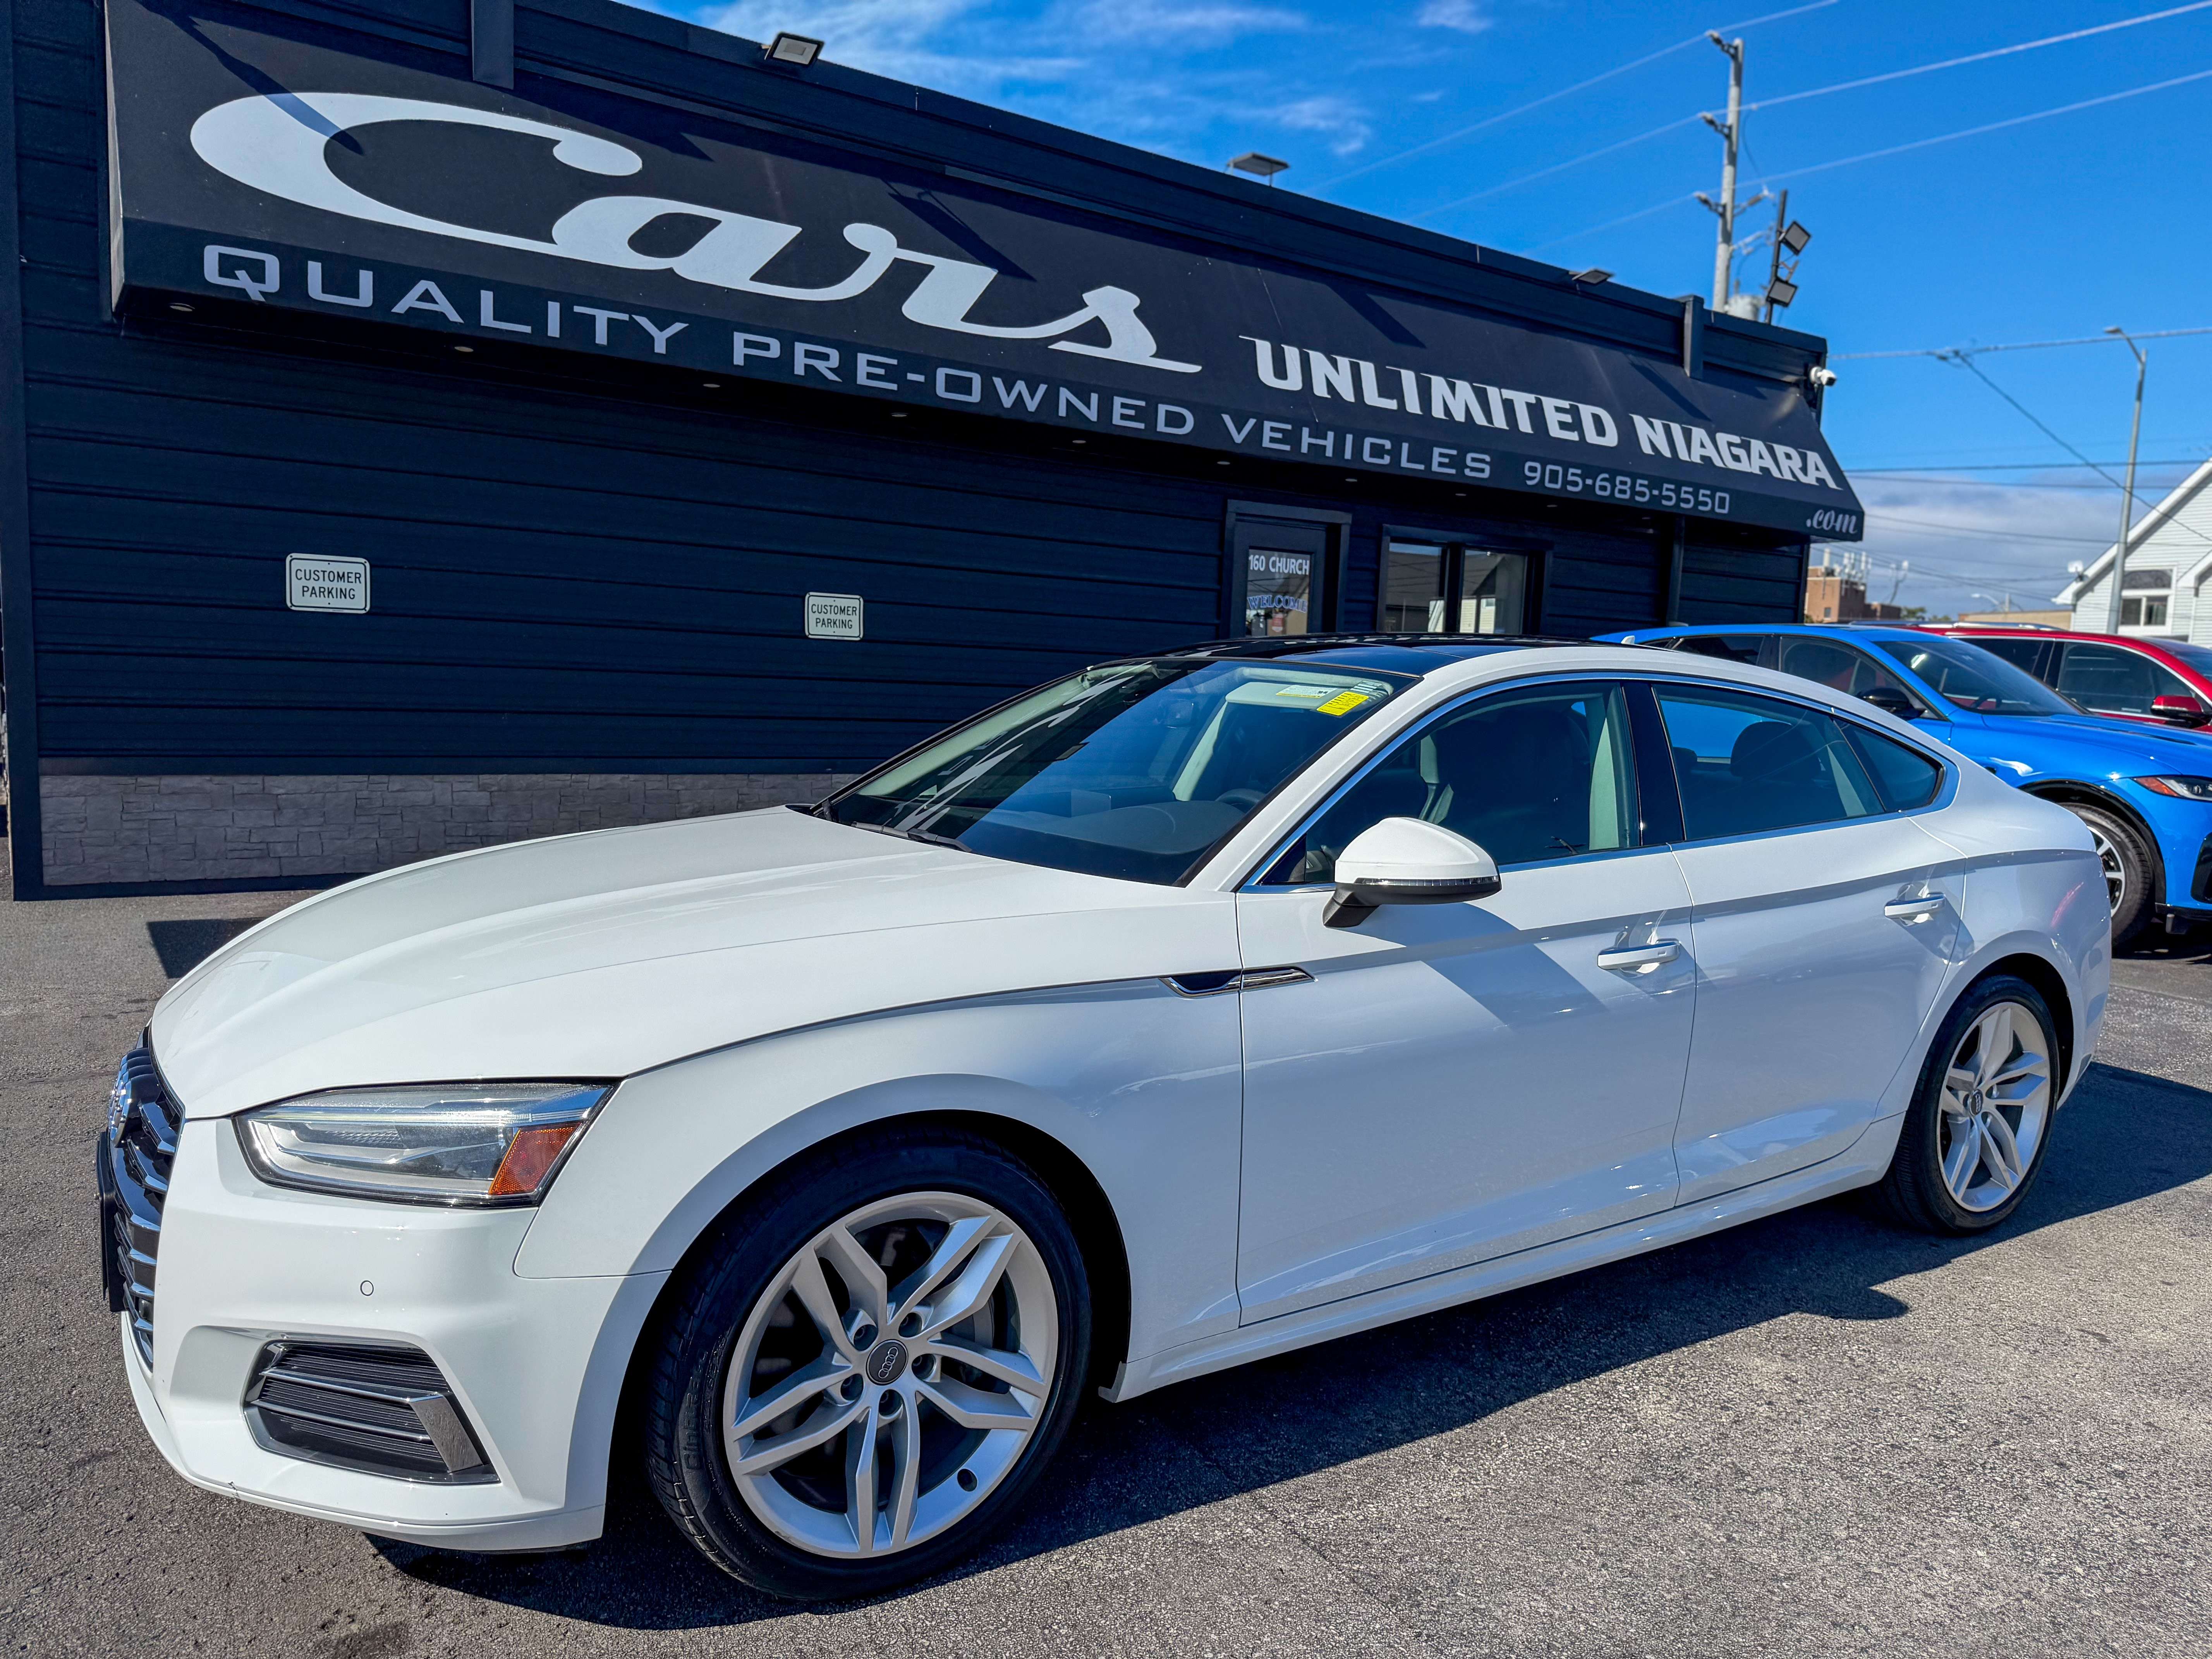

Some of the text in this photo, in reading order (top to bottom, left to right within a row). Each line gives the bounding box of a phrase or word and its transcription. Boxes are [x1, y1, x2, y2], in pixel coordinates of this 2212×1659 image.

[190, 92, 1844, 490] Cars UNLIMITED NIAGARA
[203, 245, 1730, 515] QUALITY PRE-OWNED VEHICLES 905-685-5550
[1806, 509, 1858, 534] .com
[1249, 555, 1309, 575] 160 CHURCH
[295, 568, 361, 584] CUSTOMER
[302, 586, 355, 599] PARKING
[811, 604, 857, 616] CUSTOMER
[1247, 595, 1307, 613] WELCOME
[816, 618, 852, 629] PARKING
